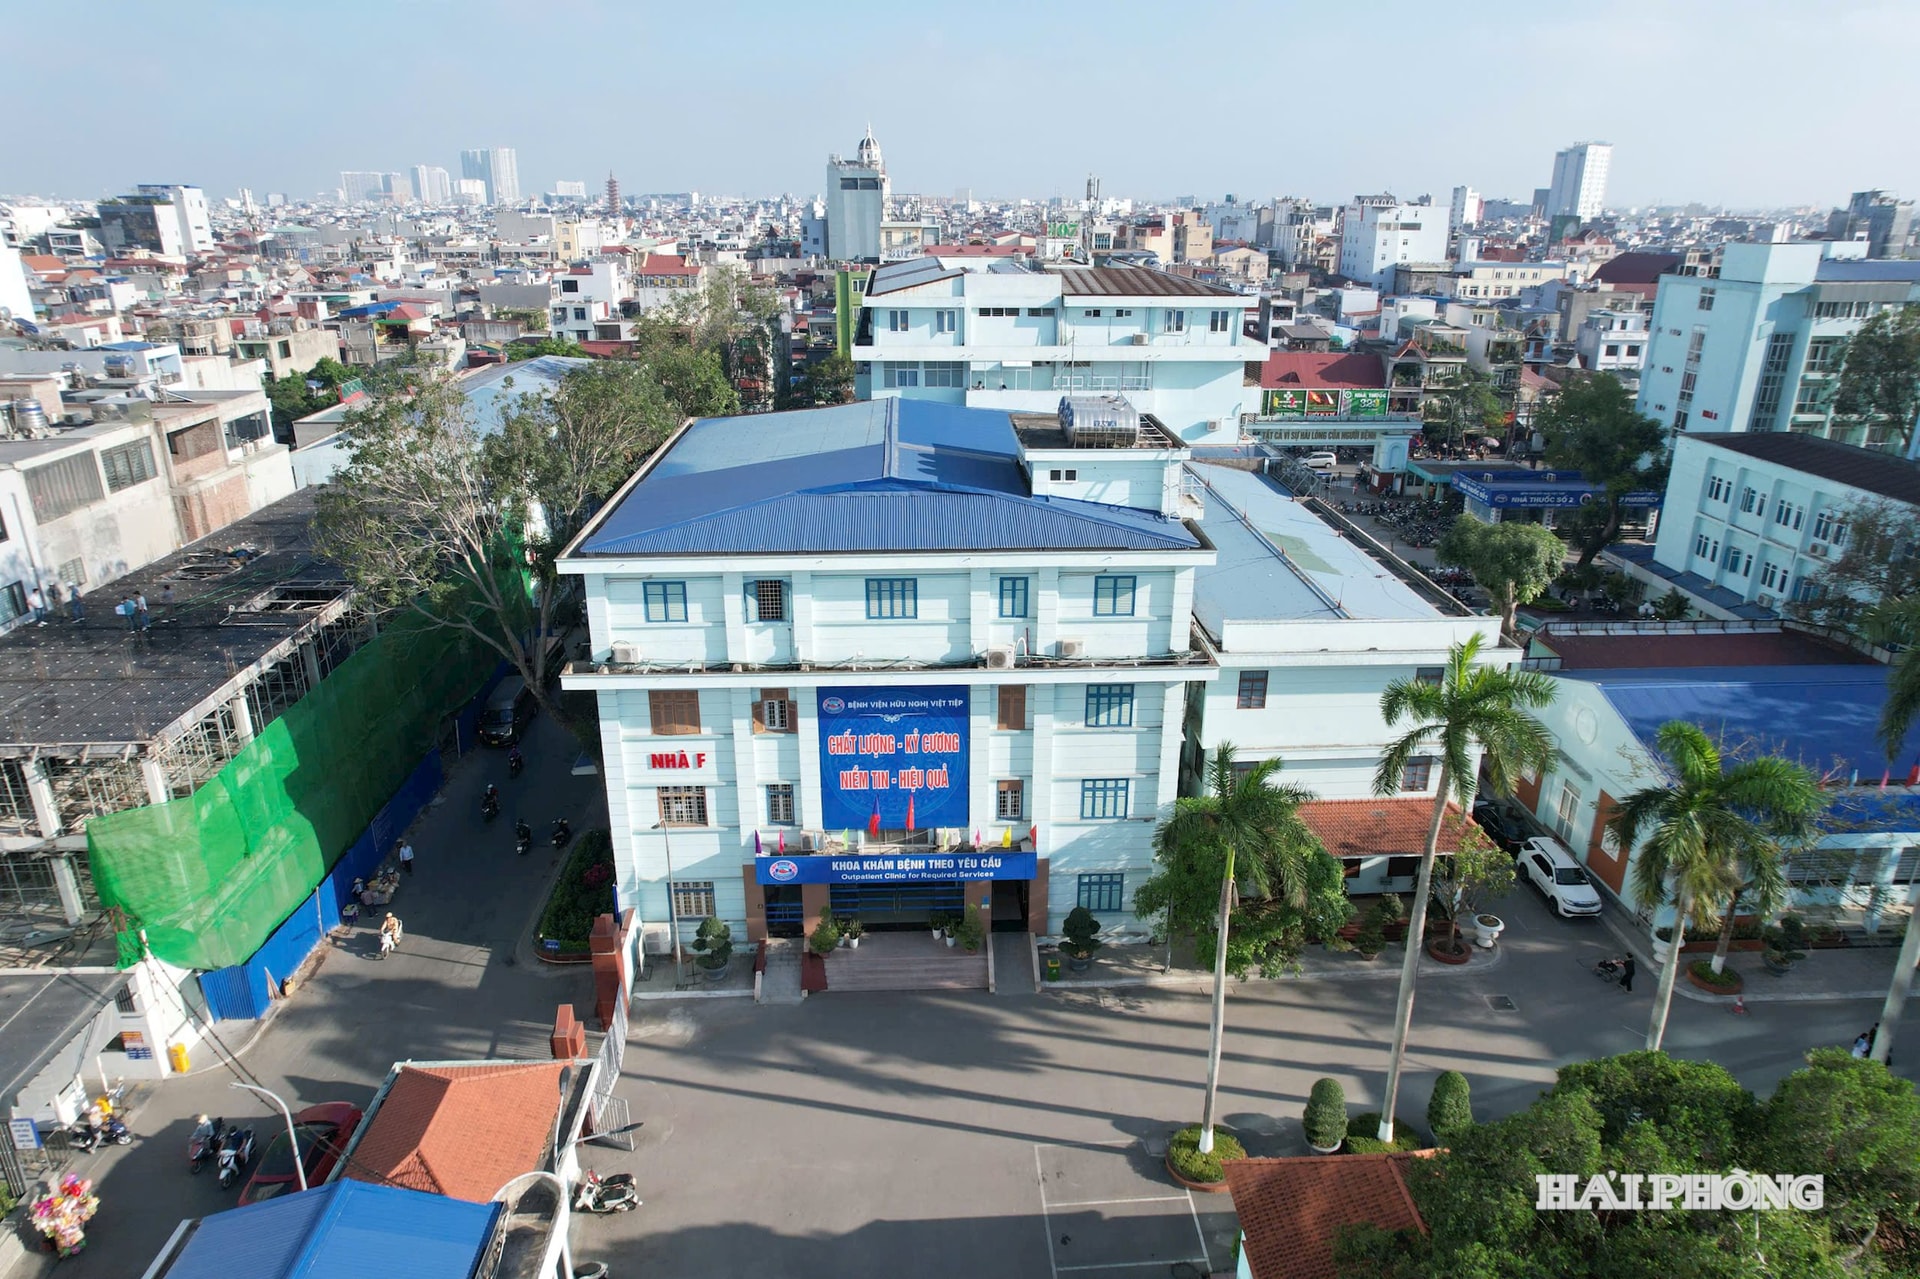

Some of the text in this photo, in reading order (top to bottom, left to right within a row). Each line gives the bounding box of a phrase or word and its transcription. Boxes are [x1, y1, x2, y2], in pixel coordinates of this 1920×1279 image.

[1529, 494, 1555, 503] THUỐC
[847, 700, 868, 710] BỆNH
[870, 700, 888, 709] VIỆN
[890, 699, 906, 708] HỮU
[908, 700, 928, 709] NGHỊ
[930, 698, 946, 708] VIỆT
[948, 698, 963, 708] TIỆP
[828, 728, 857, 755] CHẤT
[858, 733, 895, 758] LƯỢNG
[905, 728, 920, 754] KỶ
[921, 731, 960, 754] CƯƠNG
[651, 749, 706, 769] NHÀ F
[870, 770, 890, 790] TIN
[899, 766, 924, 793] HIỆU
[926, 763, 949, 791] QUẢ
[832, 861, 860, 871] KHOA
[863, 858, 894, 870] KHÁM
[897, 857, 925, 872] BỆNH
[928, 859, 954, 869] THEO
[957, 857, 978, 869] YÊU
[841, 870, 995, 881] Outpatient Clinic for Required Services
